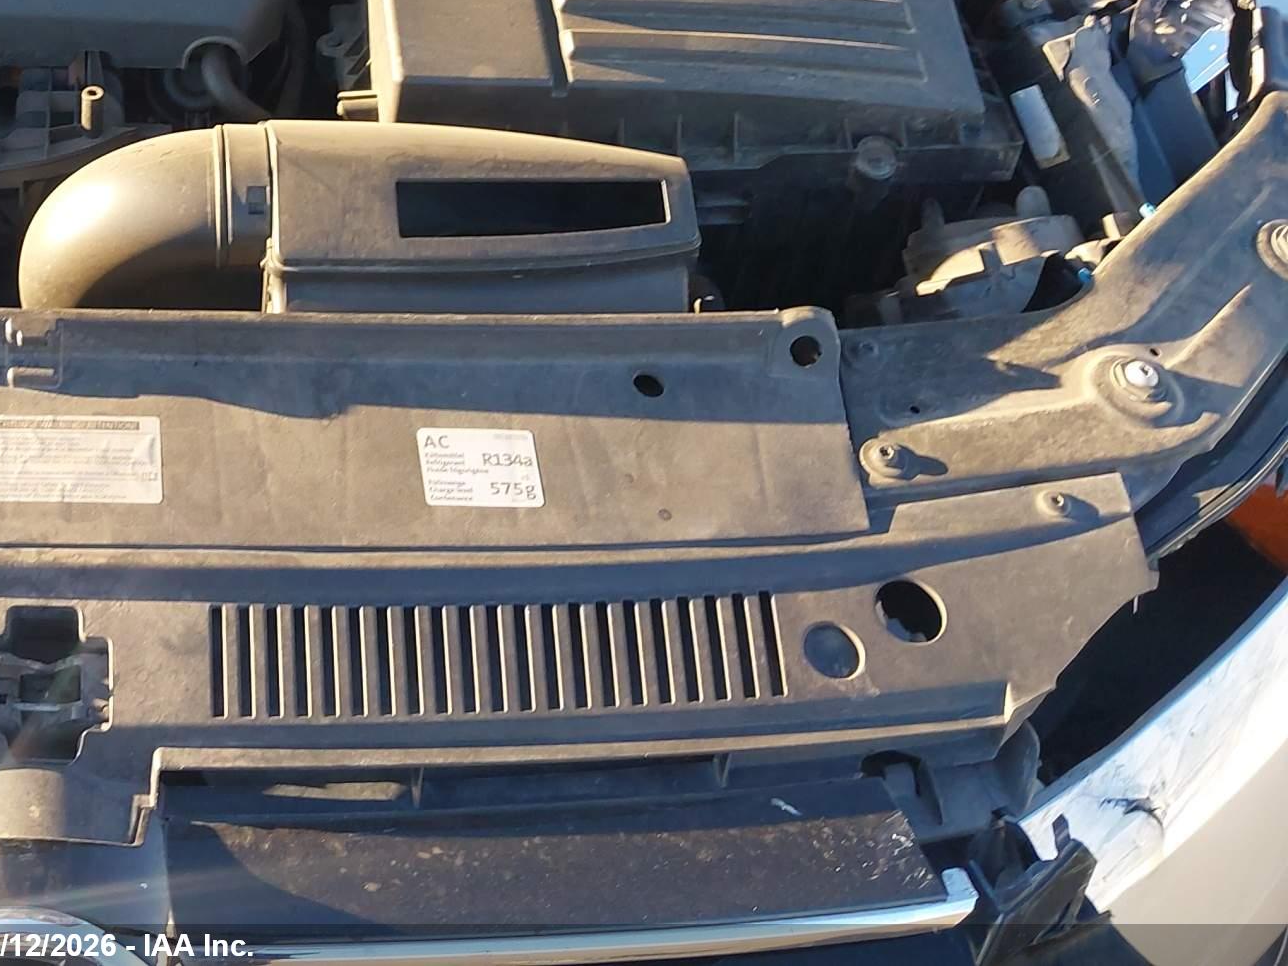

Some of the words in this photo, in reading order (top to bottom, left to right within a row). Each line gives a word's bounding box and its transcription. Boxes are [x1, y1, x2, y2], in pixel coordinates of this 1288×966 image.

[424, 435, 451, 449] AC
[482, 453, 534, 467] R134a
[490, 481, 537, 500] 575g
